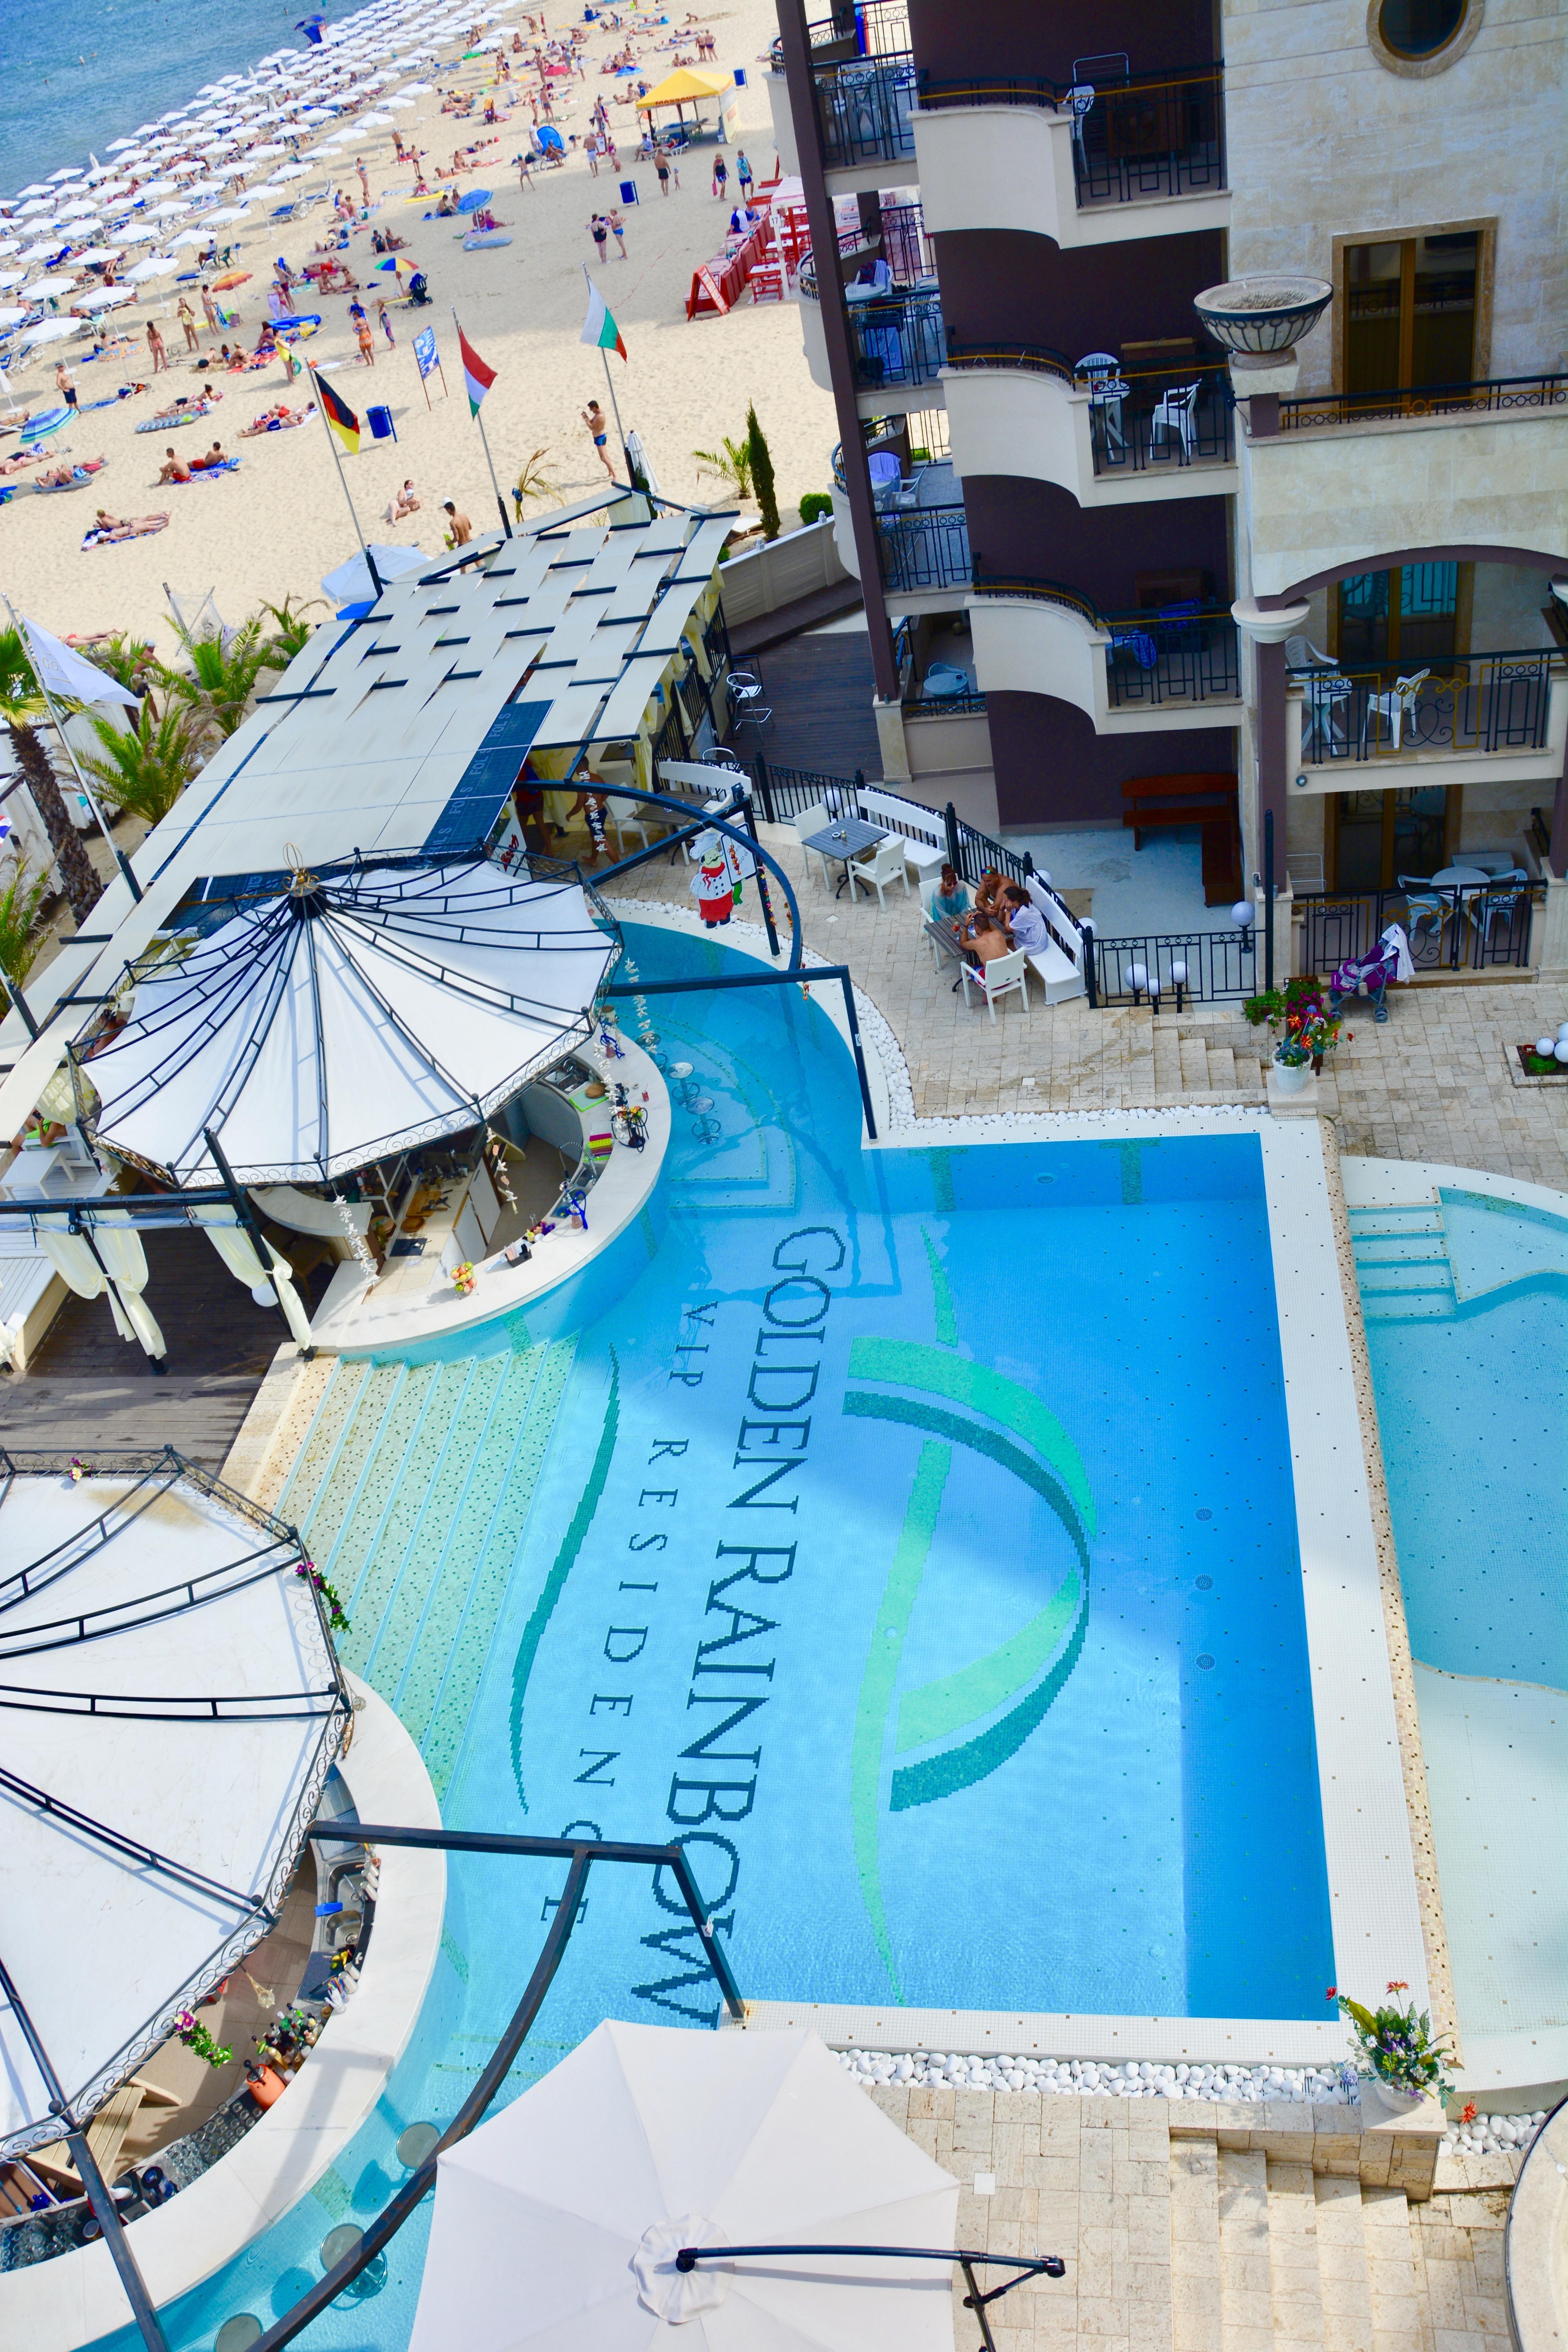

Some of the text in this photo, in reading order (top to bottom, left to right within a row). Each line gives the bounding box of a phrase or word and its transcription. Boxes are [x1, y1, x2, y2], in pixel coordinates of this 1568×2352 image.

[540, 1300, 718, 1924] VIP RESIDENCE
[630, 1226, 846, 2031] GOLDEN RAINBOW
